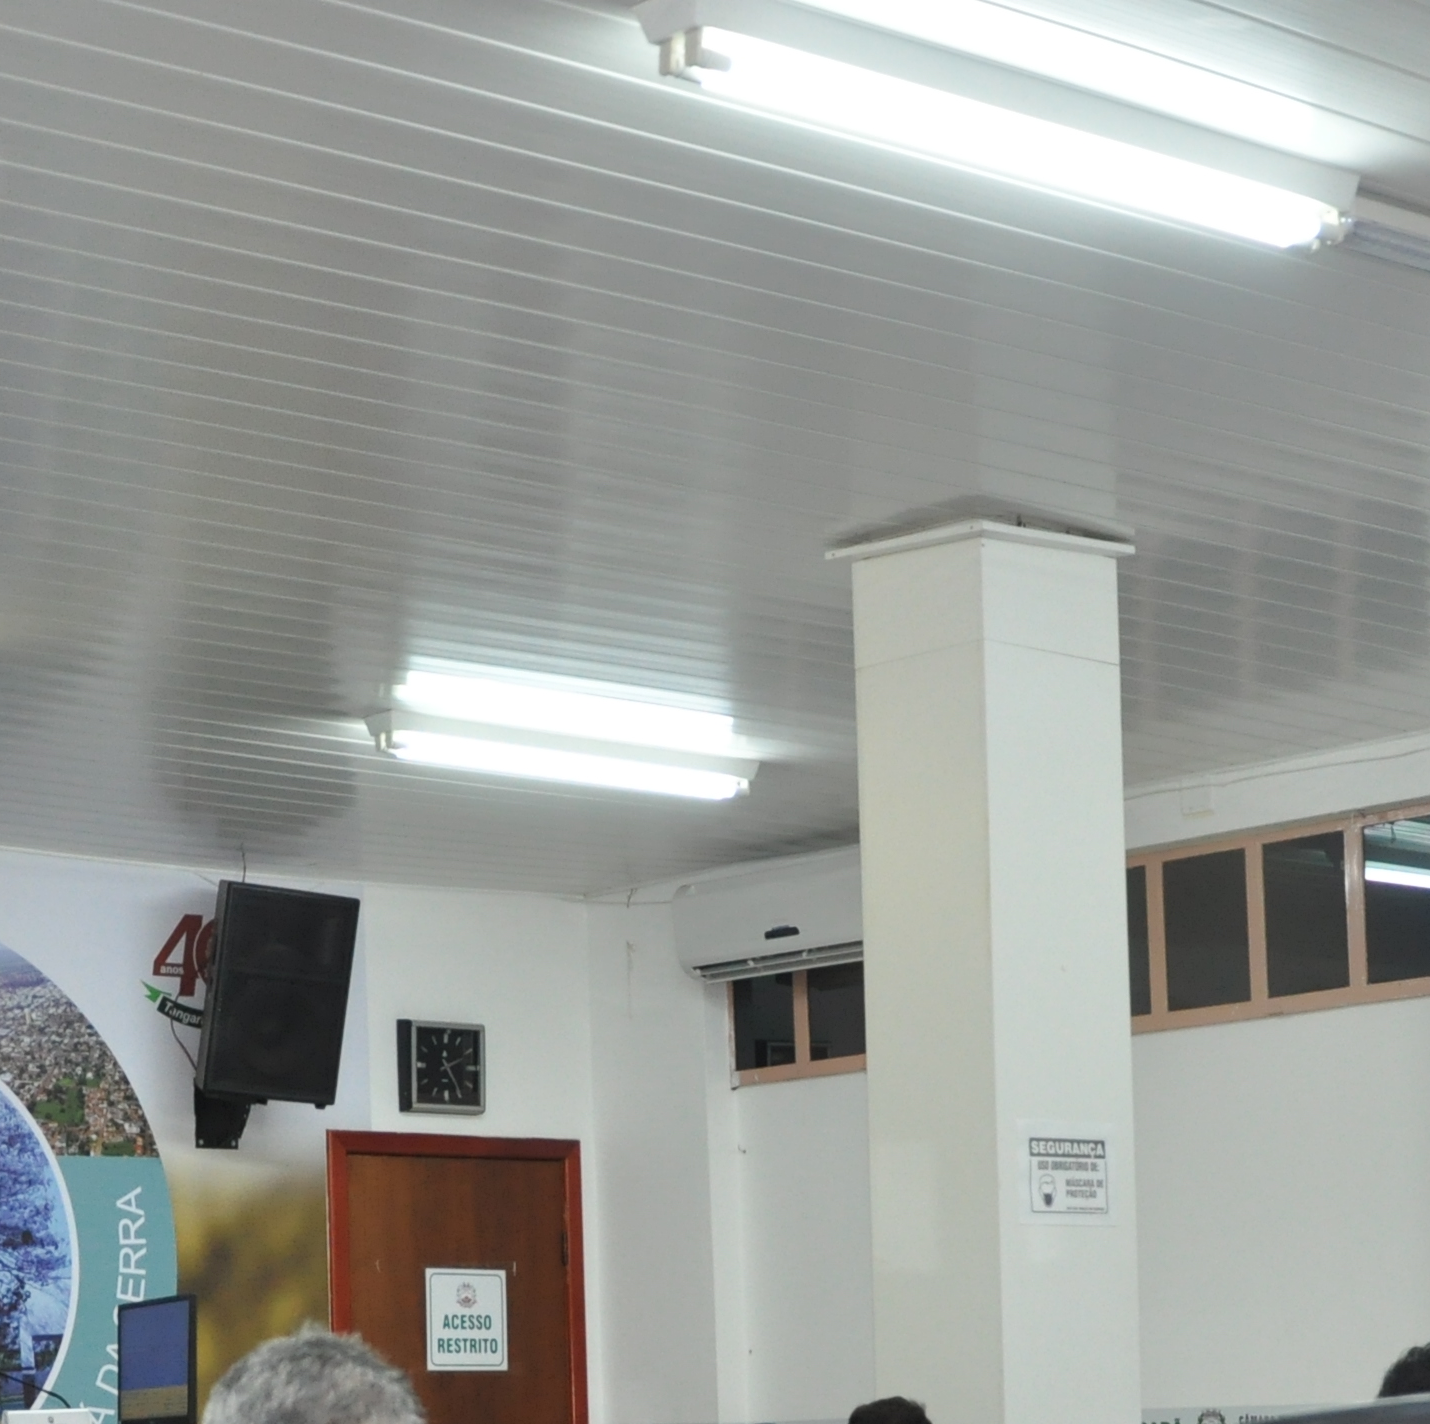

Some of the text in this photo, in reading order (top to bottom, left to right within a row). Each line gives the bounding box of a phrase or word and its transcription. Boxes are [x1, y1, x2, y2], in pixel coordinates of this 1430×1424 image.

[160, 965, 184, 975] anos
[1031, 1140, 1104, 1158] SEGURANÇA
[443, 1314, 492, 1330] ACESSO
[437, 1338, 498, 1354] RESTRITO
